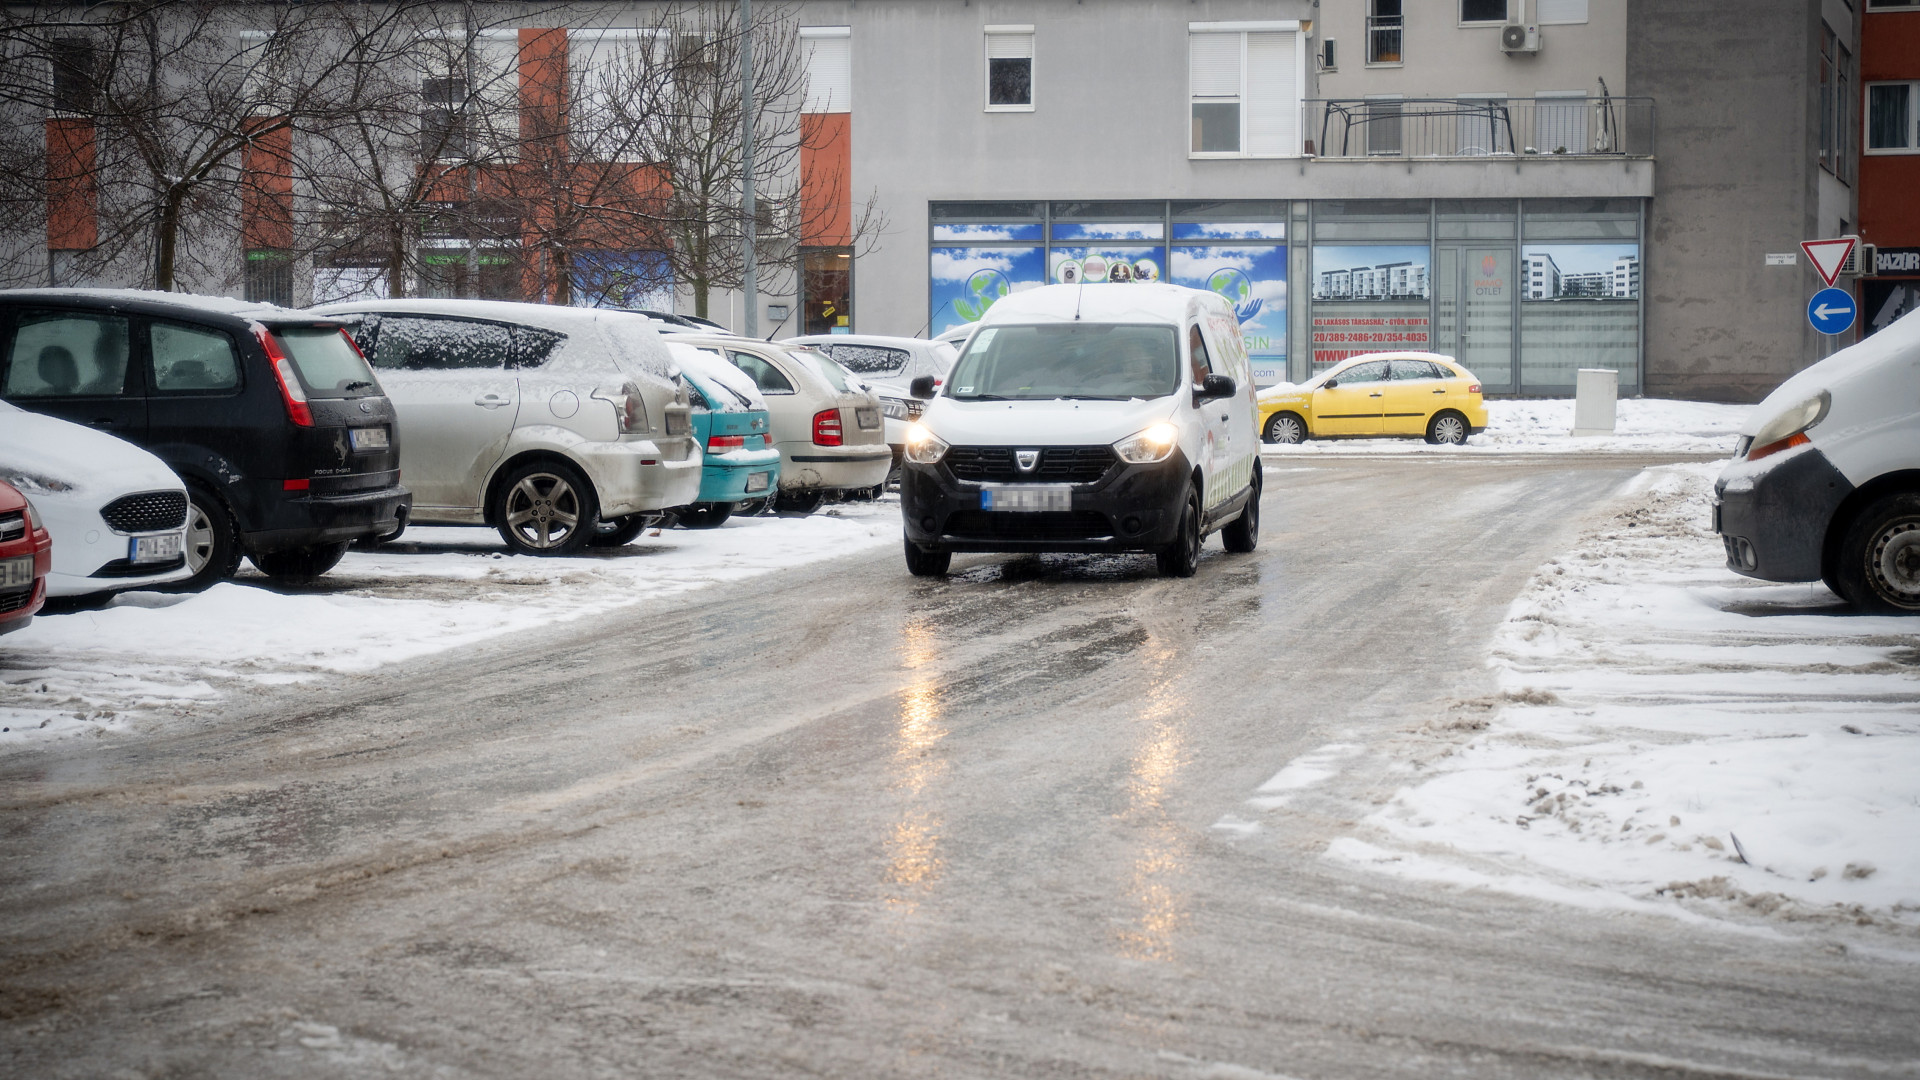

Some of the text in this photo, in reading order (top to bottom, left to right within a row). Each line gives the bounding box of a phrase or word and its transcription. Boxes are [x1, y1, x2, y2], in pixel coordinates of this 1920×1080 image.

[1474, 279, 1503, 287] IMMO
[1475, 287, 1501, 296] OTLET
[1314, 318, 1323, 326] 85
[1323, 317, 1350, 326] LAKÁSOS
[1351, 317, 1385, 326] TÁRSASHÁZ
[1407, 318, 1422, 326] KERT
[1243, 336, 1269, 350] SIN
[1253, 369, 1275, 377] com
